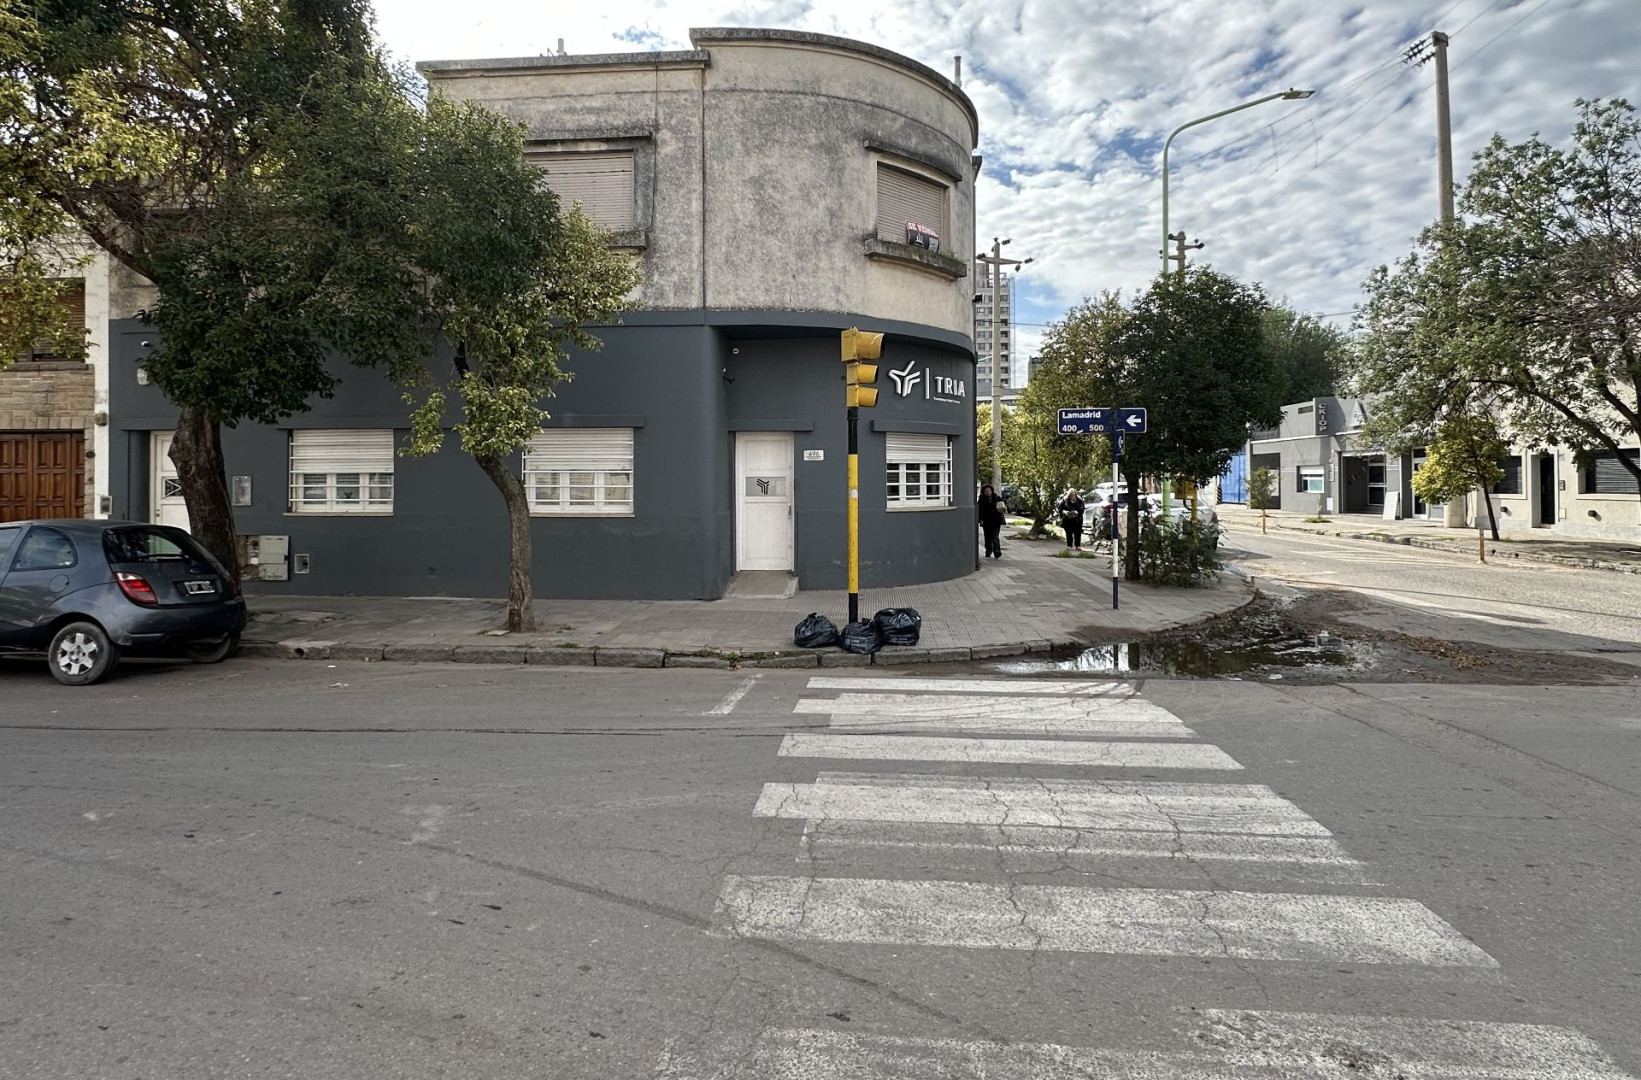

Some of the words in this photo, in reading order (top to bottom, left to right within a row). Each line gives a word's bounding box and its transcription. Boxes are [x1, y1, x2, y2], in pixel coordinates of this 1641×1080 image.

[934, 376, 966, 397] TRIA
[1062, 411, 1101, 419] Lamadrid
[1318, 402, 1328, 432] CKIOP
[1062, 424, 1078, 432] 400
[1089, 424, 1104, 432] 500
